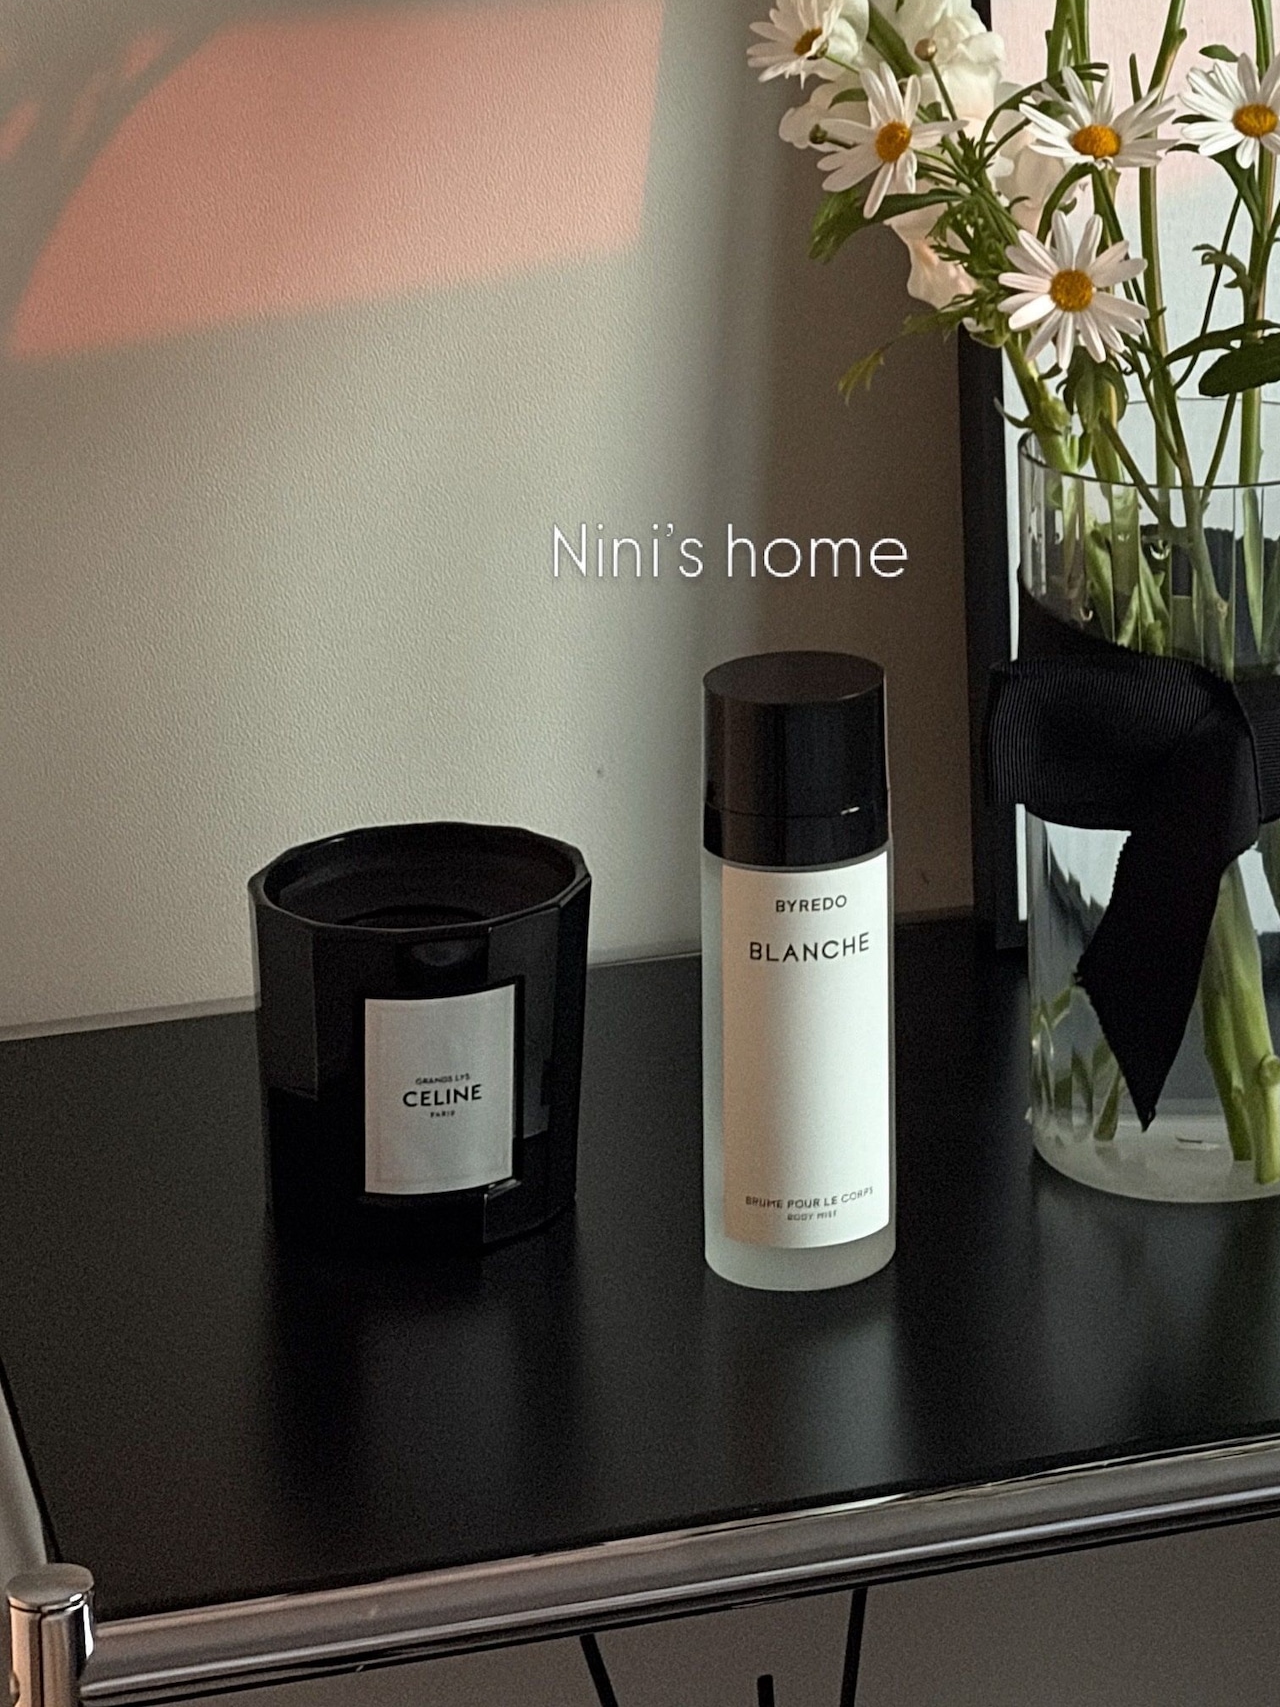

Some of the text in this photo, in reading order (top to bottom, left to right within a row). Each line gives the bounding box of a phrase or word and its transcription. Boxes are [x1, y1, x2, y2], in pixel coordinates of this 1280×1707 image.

[775, 894, 848, 913] BYREDO
[749, 931, 870, 963] BLANCHE
[402, 1084, 483, 1108] CELINE
[745, 1186, 874, 1209] BRUME POUR LE CORPS
[786, 1212, 814, 1221] BODY
